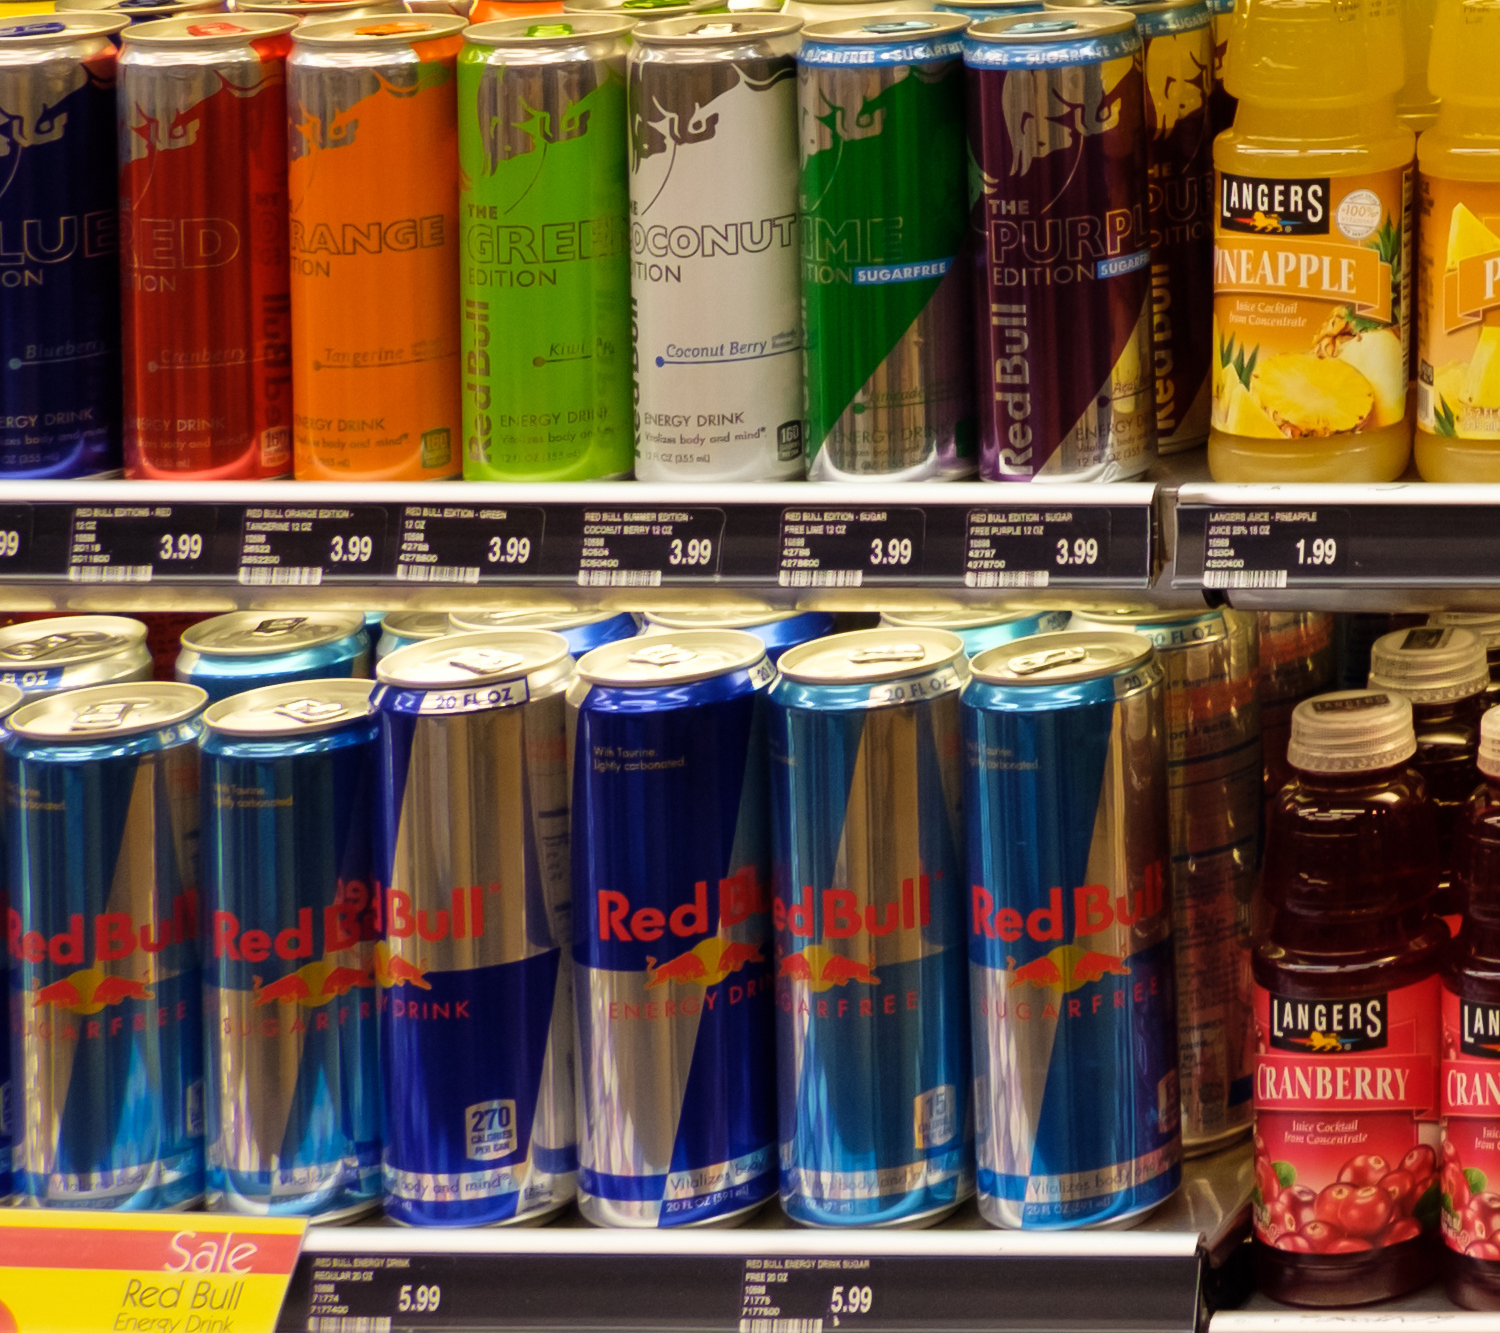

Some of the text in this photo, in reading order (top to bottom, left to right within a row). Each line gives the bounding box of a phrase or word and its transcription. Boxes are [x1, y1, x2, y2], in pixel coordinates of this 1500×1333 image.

[858, 261, 947, 282] SUGARFREE
[666, 337, 768, 360] Coconut Berry
[645, 411, 743, 428] ENERGY DRINK
[159, 534, 202, 560] 3.99
[329, 536, 373, 562] 3.99
[488, 537, 530, 564] 3.99
[669, 538, 712, 565] 3.99
[870, 538, 912, 564] 3.99
[1056, 538, 1099, 564] 3.99
[1296, 538, 1337, 564] 1.99
[436, 687, 514, 710] 20 FL OZ
[598, 881, 708, 942] Red
[471, 1106, 511, 1134] 270
[162, 1230, 258, 1274] Sale
[122, 1279, 244, 1311] Red Bull
[398, 1284, 441, 1313] 5.99
[830, 1286, 873, 1313] 5.99
[114, 1313, 234, 1333] Energy Drink
